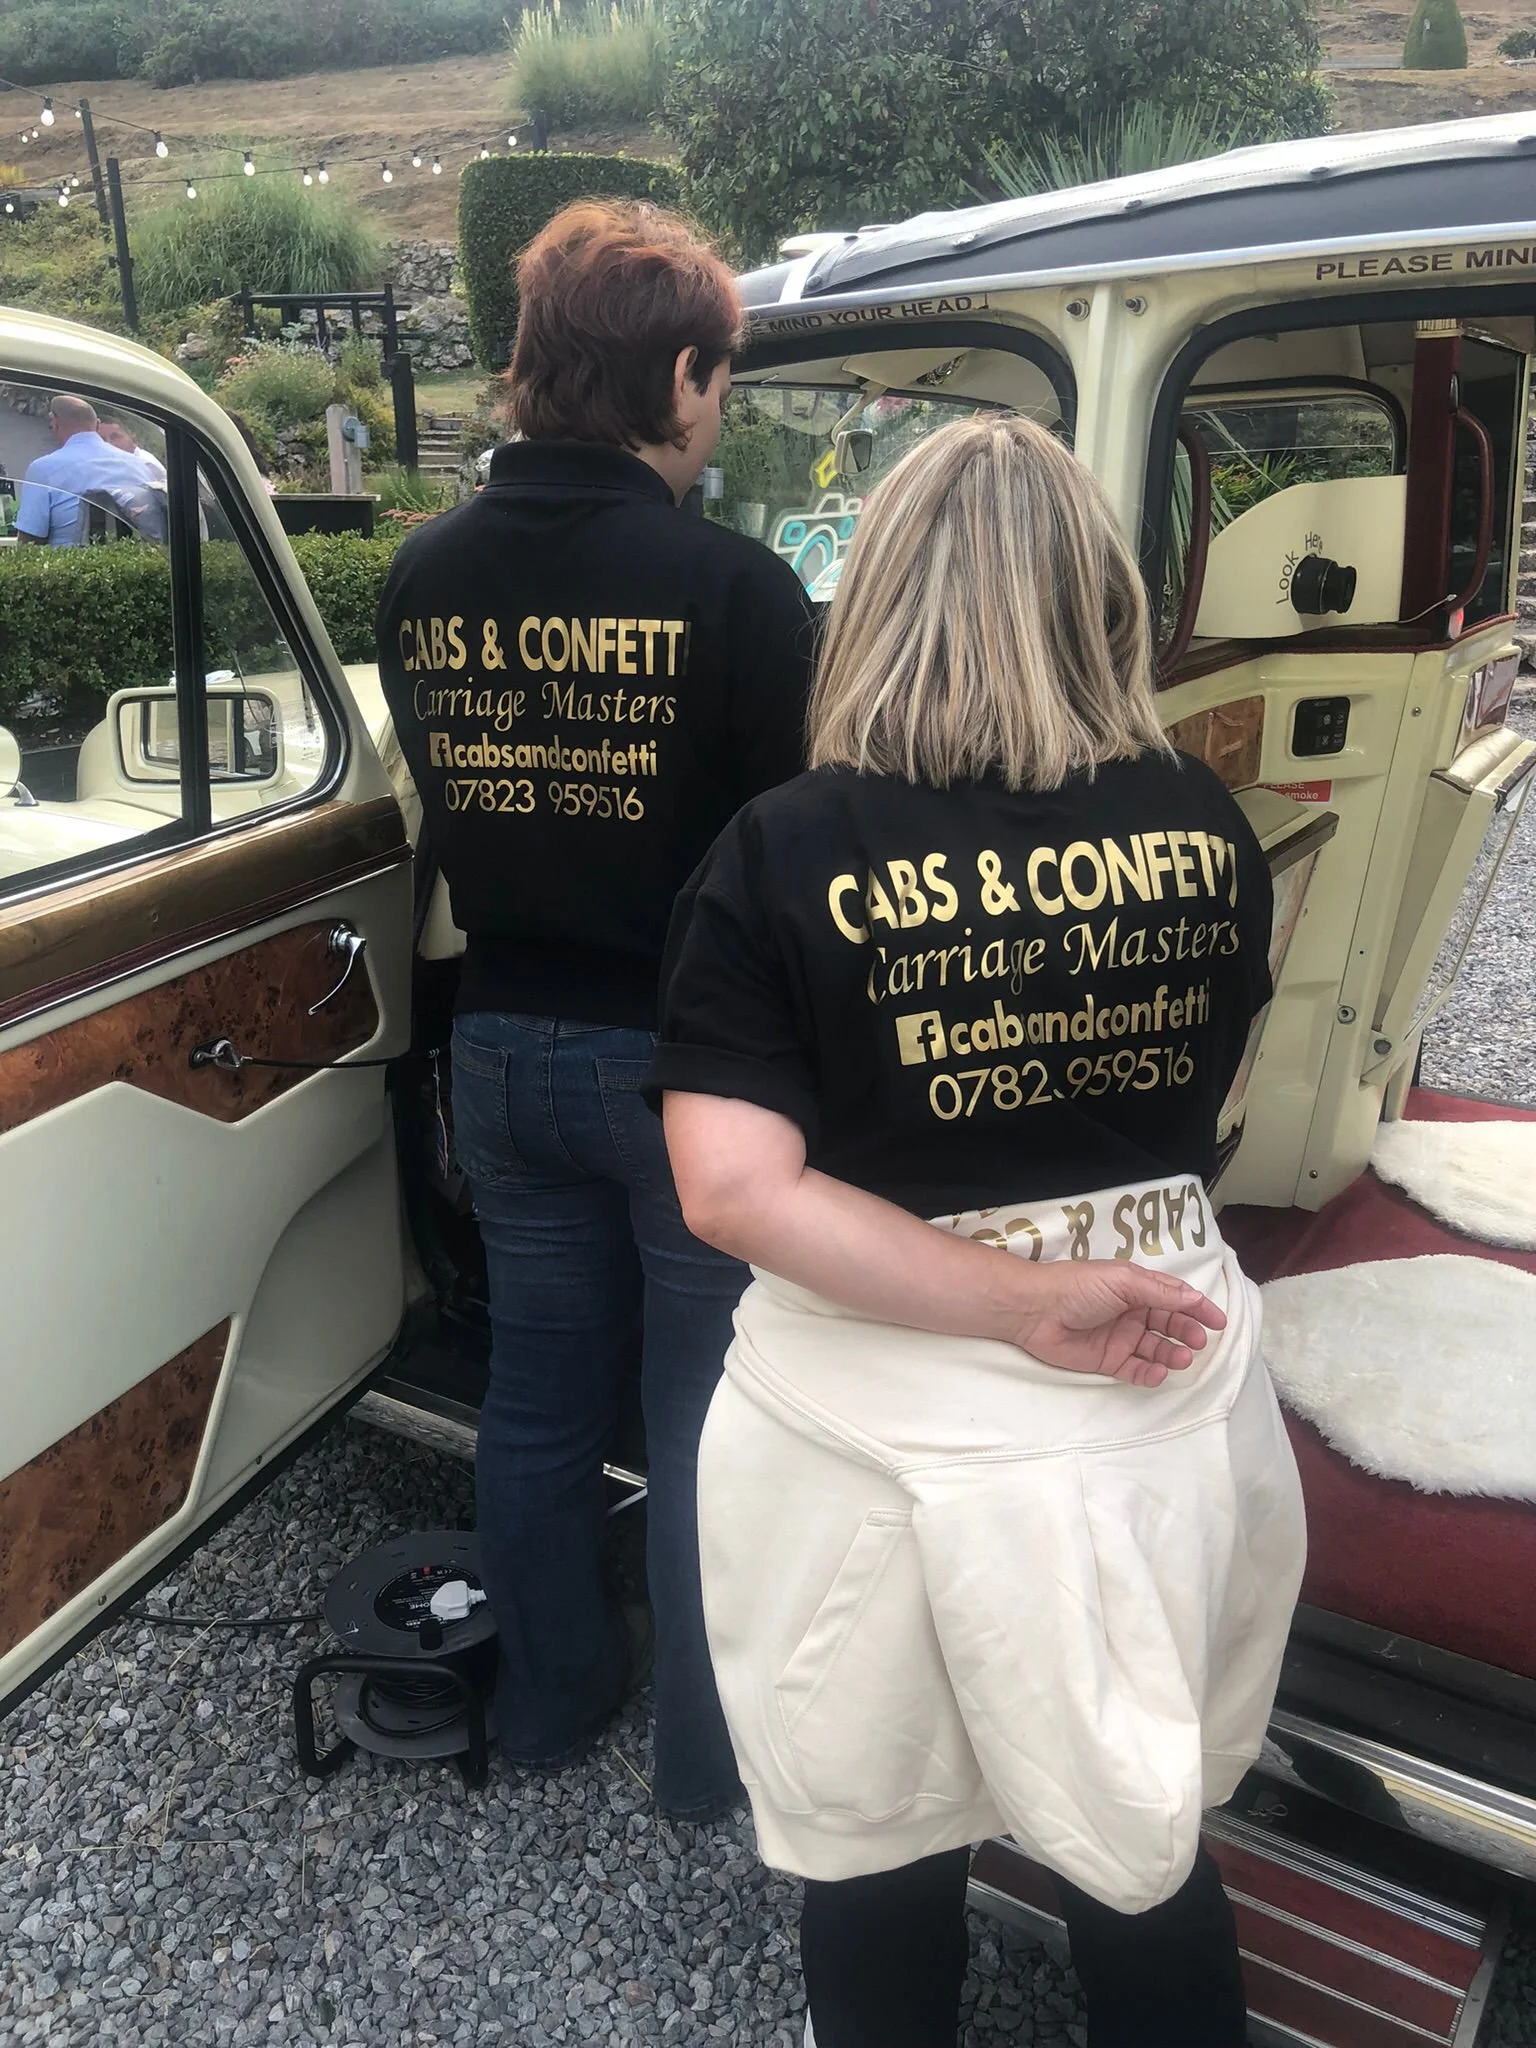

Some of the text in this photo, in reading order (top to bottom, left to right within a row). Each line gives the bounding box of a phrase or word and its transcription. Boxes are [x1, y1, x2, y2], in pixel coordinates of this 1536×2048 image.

[1316, 247, 1536, 280] PLEASE MIN
[768, 315, 823, 333] MIND
[828, 306, 895, 325] YOUR
[1276, 551, 1299, 605] Look
[399, 615, 467, 671] CABS
[481, 618, 507, 670] &
[414, 677, 678, 731] Carriage Masters
[445, 779, 645, 821] 07823 959516
[828, 851, 959, 944] CABS
[977, 849, 1021, 916] &
[1063, 916, 1240, 975] Masters
[949, 977, 1210, 1055] cabandconfetti
[929, 1042, 1194, 1120] 0782 959516
[1061, 1201, 1095, 1261] &
[1113, 1183, 1206, 1260] CABS
